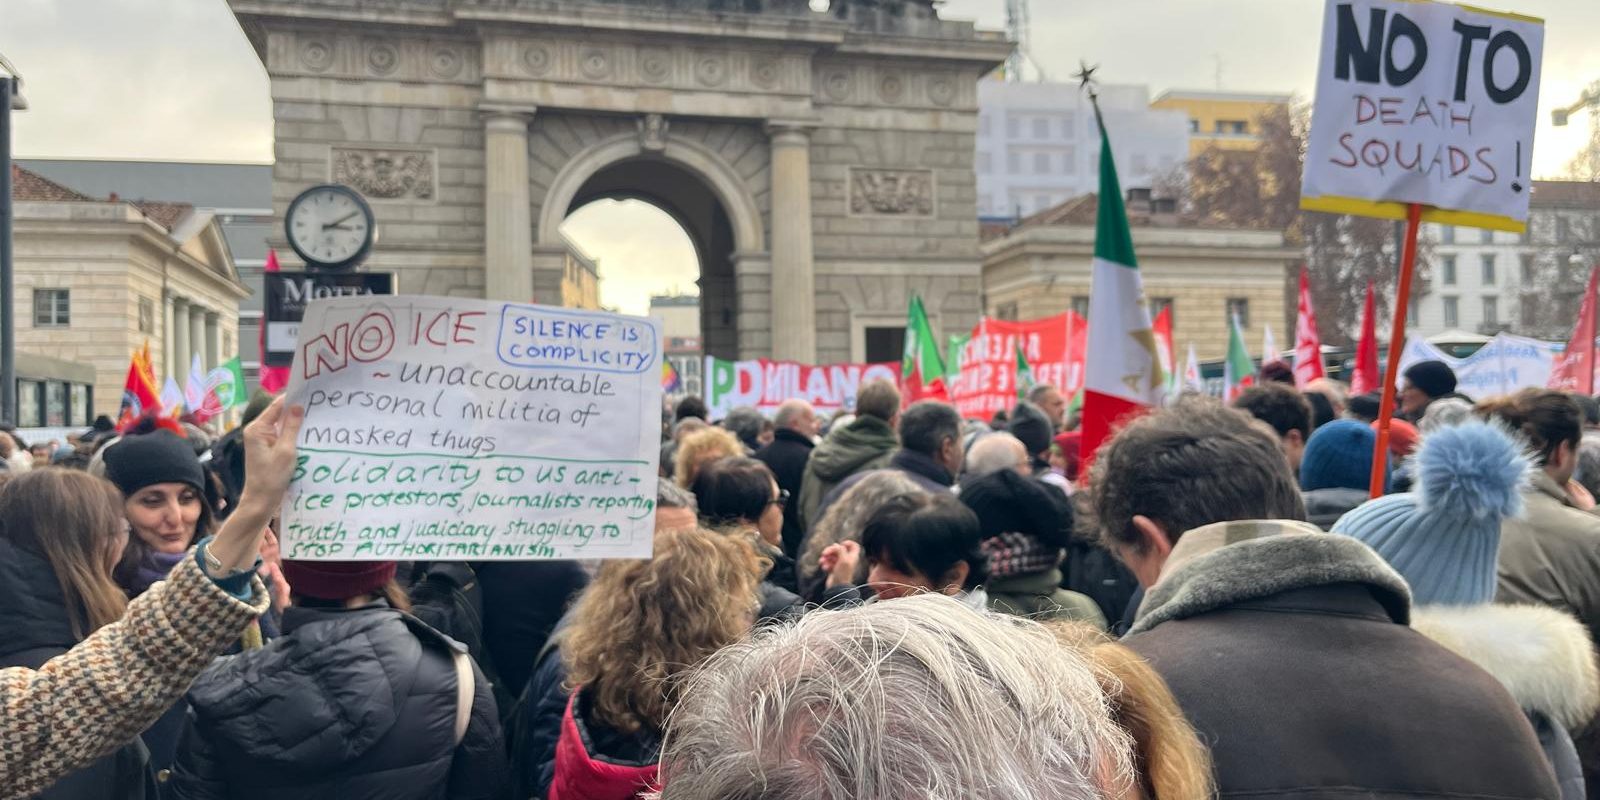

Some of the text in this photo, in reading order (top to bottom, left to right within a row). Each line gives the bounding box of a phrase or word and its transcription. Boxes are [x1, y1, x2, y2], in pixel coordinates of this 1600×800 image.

[1334, 4, 1532, 105] NO TO
[1353, 95, 1475, 135] DEATH
[304, 311, 487, 379] NO ICE
[514, 316, 639, 342] SILENCE IS
[400, 362, 616, 397] unaccountable
[304, 388, 601, 428] personal militia of
[304, 425, 497, 458] masked thugs
[495, 466, 525, 483] to
[294, 489, 656, 520] ice protestors, journalists reporting
[288, 516, 621, 548] truth and judiciary stuggling to
[289, 540, 344, 558] STOP
